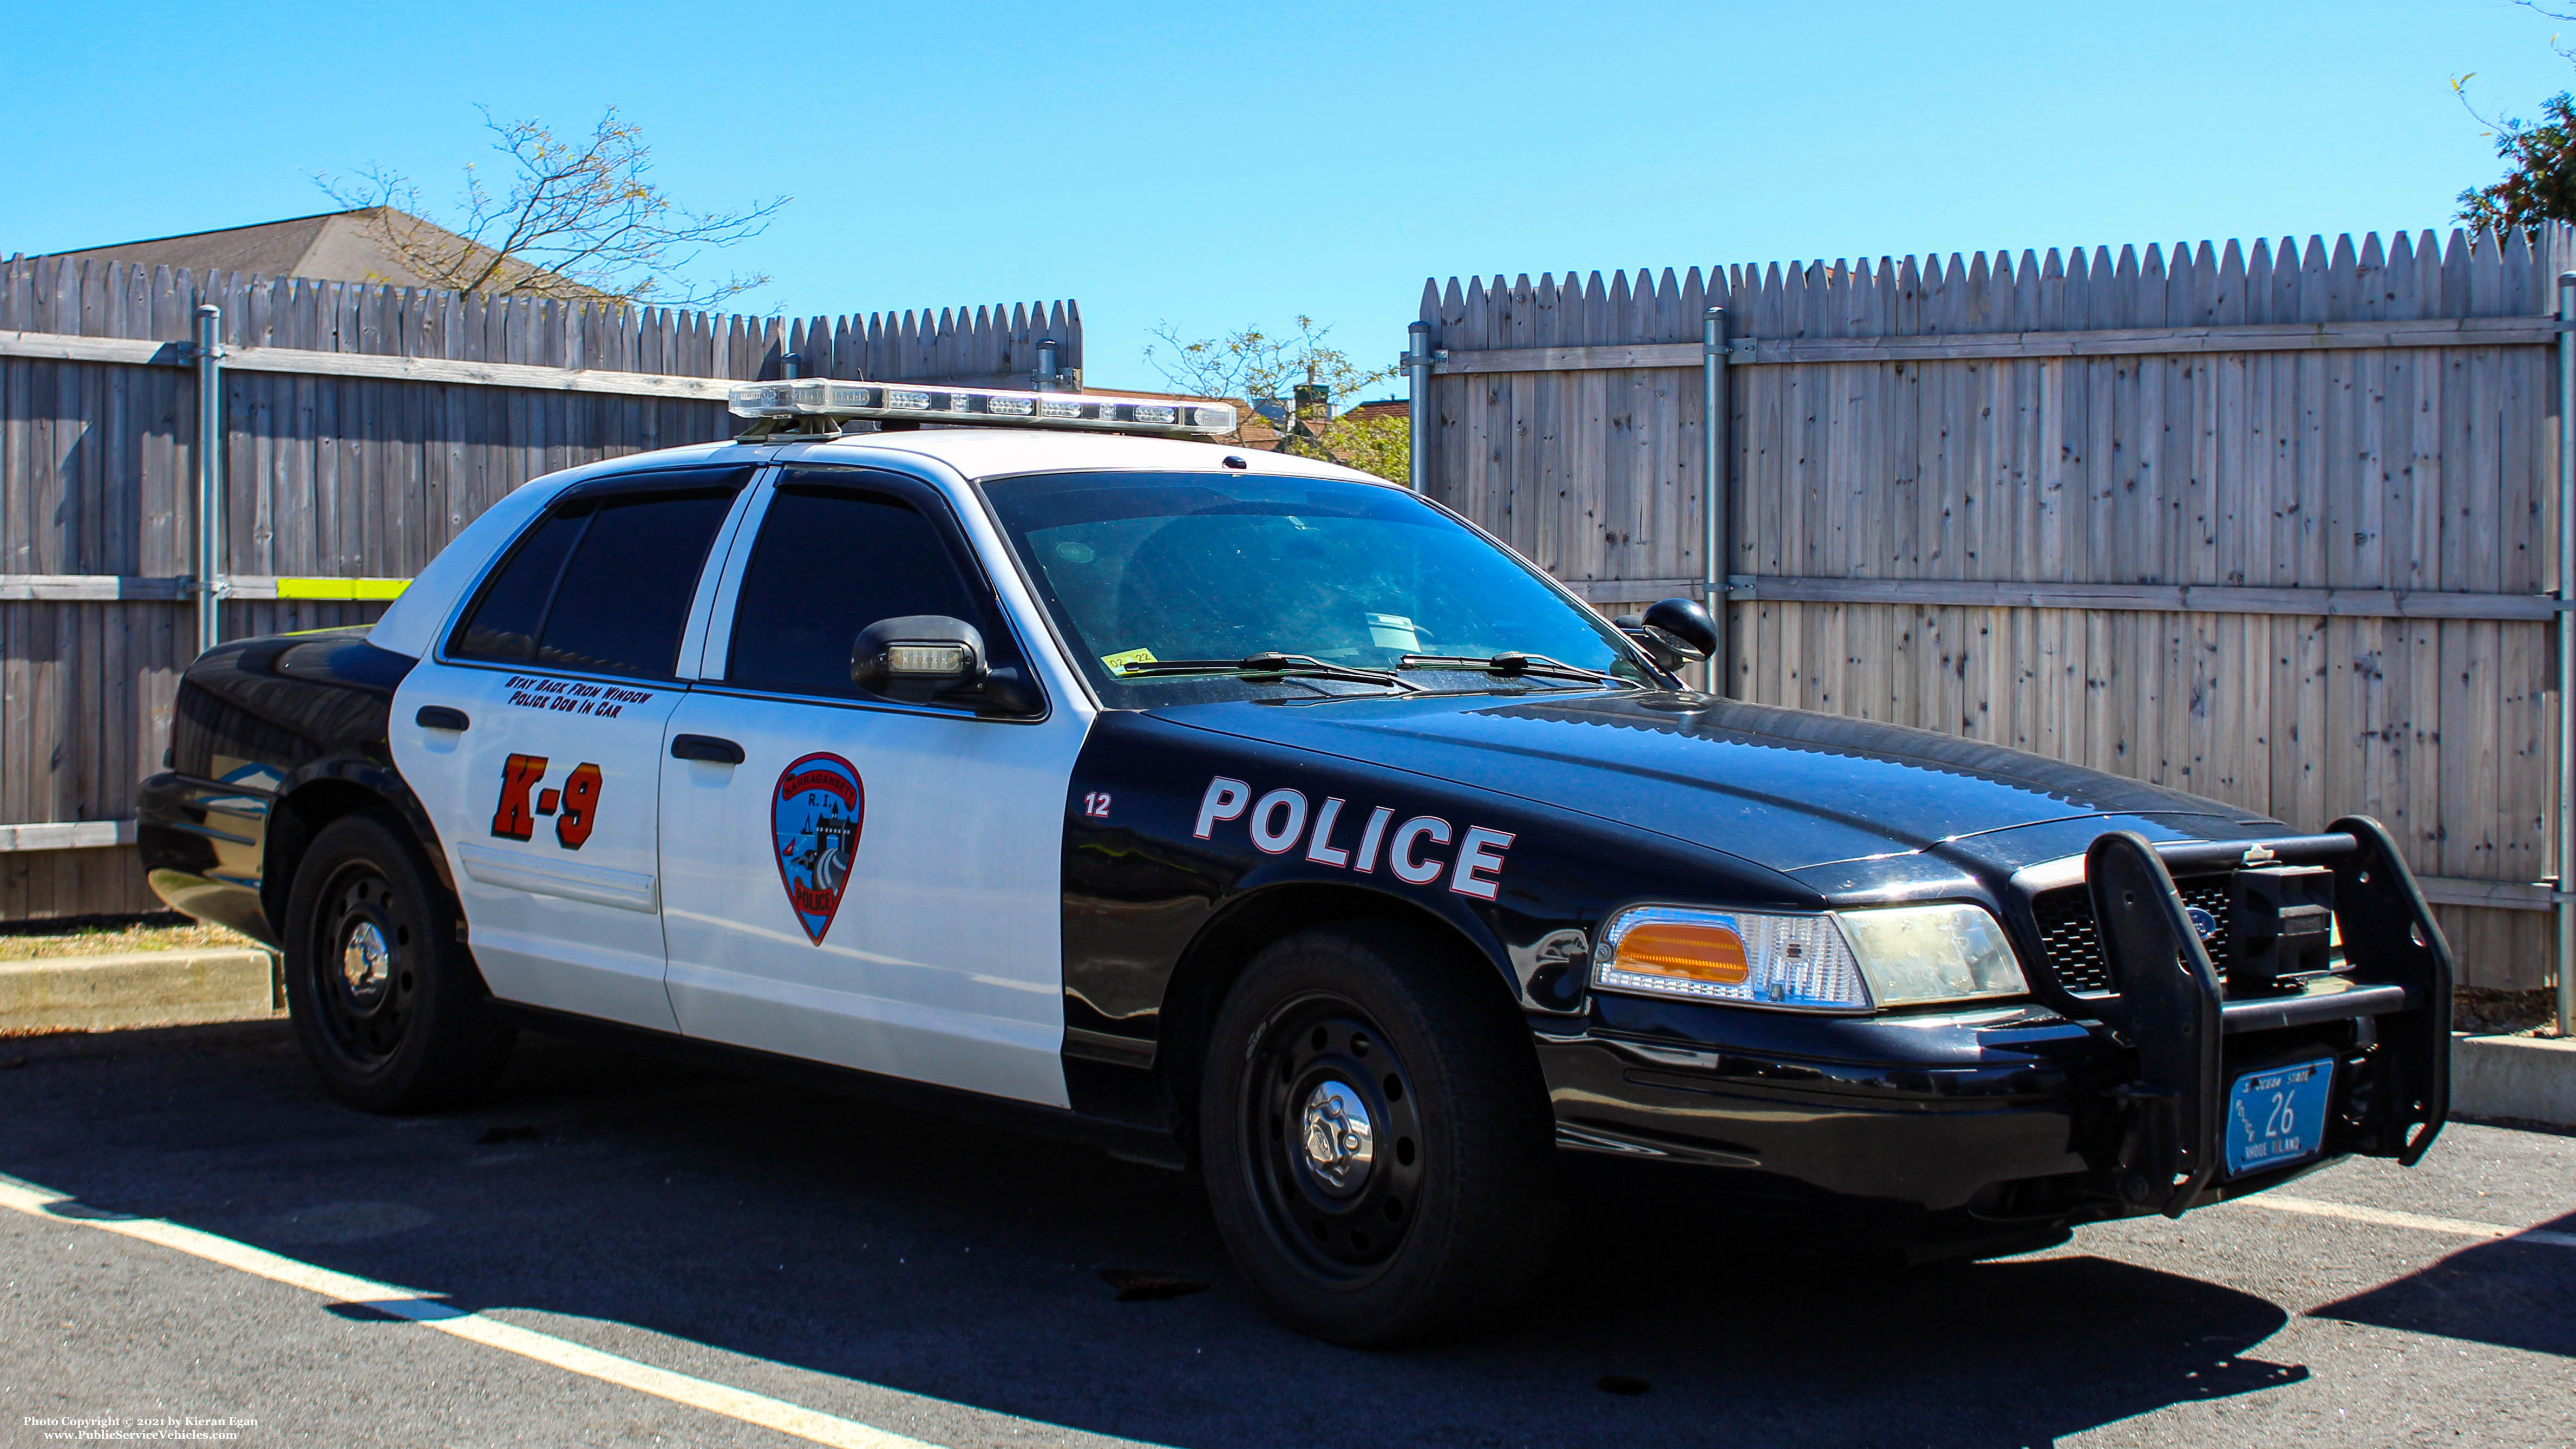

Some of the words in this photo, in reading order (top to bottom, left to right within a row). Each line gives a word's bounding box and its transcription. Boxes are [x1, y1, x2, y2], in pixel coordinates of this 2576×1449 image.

[1109, 658, 1125, 668] 02
[1135, 652, 1152, 662] 22
[784, 774, 855, 800] NARRAGANSETT
[490, 753, 603, 851] K-9
[1084, 791, 1112, 818] 12
[1193, 775, 1516, 901] POLICE
[795, 887, 831, 911] POLICE
[2265, 1088, 2296, 1138] 26
